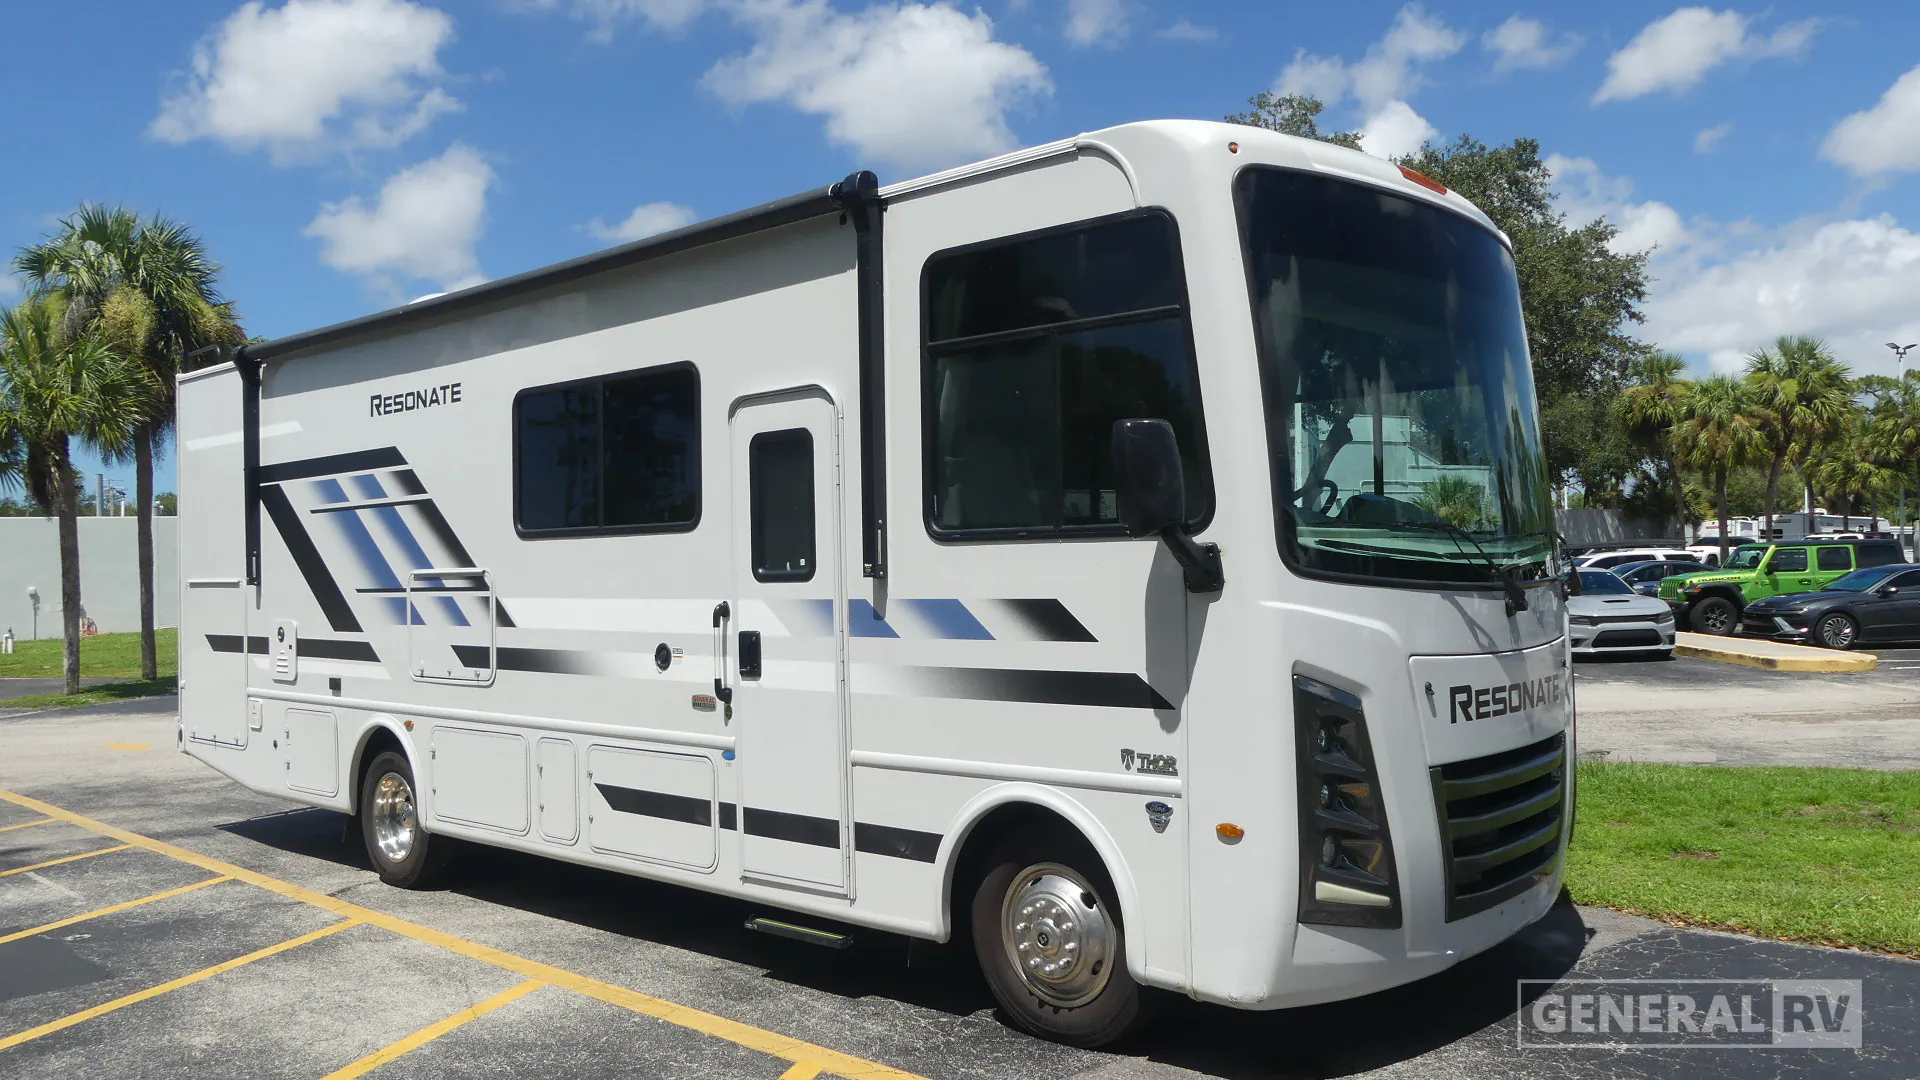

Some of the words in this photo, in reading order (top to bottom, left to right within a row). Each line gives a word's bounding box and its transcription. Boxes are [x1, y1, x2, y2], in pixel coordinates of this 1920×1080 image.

[370, 382, 462, 418] RESONATE
[1449, 673, 1560, 724] RESONATE
[1136, 752, 1179, 772] THOR
